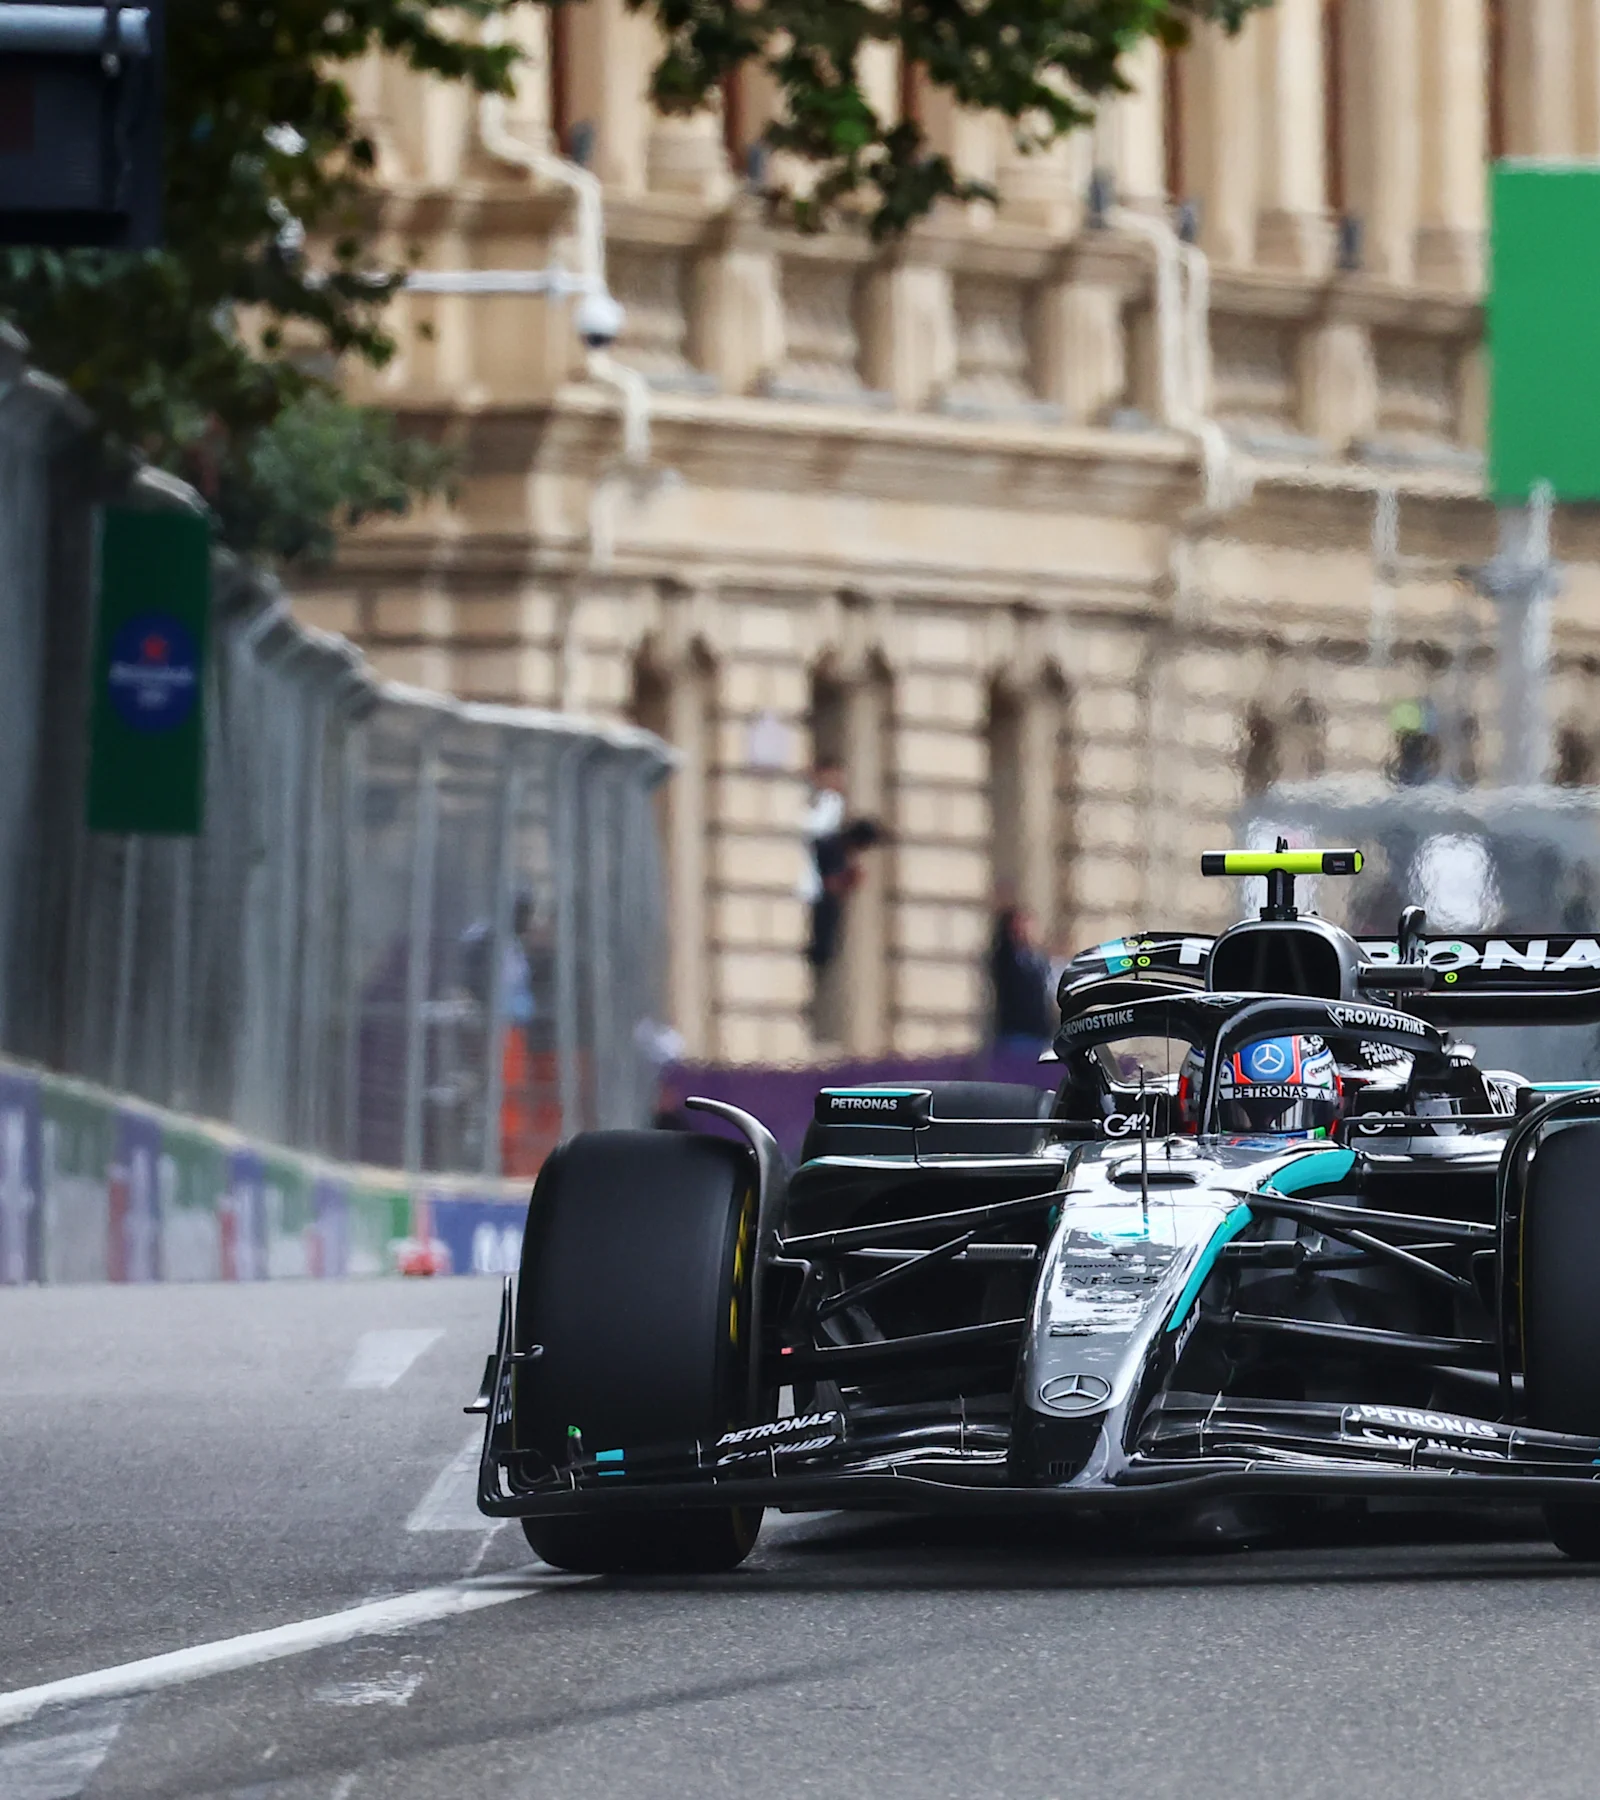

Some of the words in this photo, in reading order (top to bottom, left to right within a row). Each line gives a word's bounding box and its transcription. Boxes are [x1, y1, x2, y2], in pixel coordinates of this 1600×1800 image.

[1334, 1007, 1426, 1036] CROWDSTRIKE
[830, 1098, 898, 1110] PETRONAS
[1233, 1085, 1308, 1099] PETRONAS
[715, 1410, 838, 1447] PETRONAS
[1359, 1404, 1499, 1438] PETRONAS
